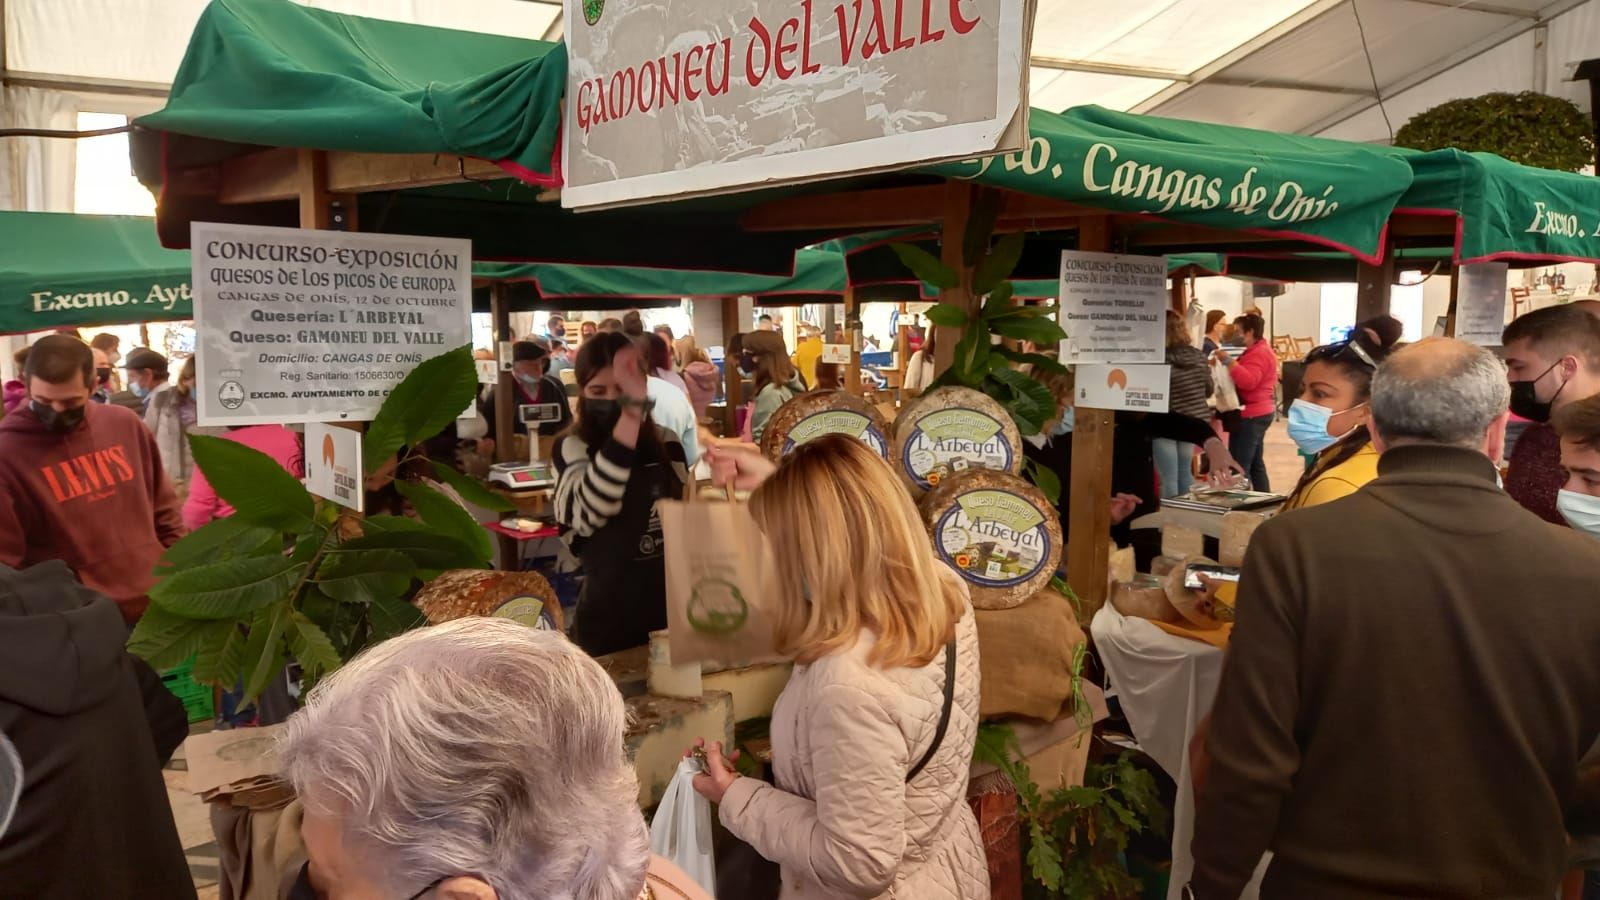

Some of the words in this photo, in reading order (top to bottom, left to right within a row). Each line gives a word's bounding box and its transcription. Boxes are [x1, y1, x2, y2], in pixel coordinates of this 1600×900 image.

[577, 37, 731, 136] GAMONEU
[745, 0, 821, 87] DEL
[1083, 143, 1223, 214] Cangas
[1226, 167, 1267, 215] de
[207, 241, 458, 270] CONCURSO-EXPOSICIÓN
[210, 267, 273, 286] QUESOS
[278, 267, 298, 286] DE
[302, 268, 330, 287] LOS
[334, 272, 376, 290] PICOS
[380, 272, 398, 289] DE
[402, 276, 457, 294] EUROPA
[31, 290, 139, 312] Excmo.
[217, 291, 280, 302] CANGAS
[284, 292, 304, 302] DE
[310, 293, 350, 304] ONÍS,
[356, 296, 367, 305] 12
[372, 295, 391, 305] DE
[395, 297, 457, 307] OCTUBRE
[251, 309, 334, 322] Quesería:
[229, 330, 292, 344] Queso:
[297, 330, 367, 344] GAMONEU
[372, 331, 399, 344] DEL
[404, 332, 445, 345] VALLE
[258, 353, 319, 363] Domicilio:
[322, 353, 373, 363] CANGAS
[377, 353, 392, 363] DE
[395, 352, 422, 363] ONÍS
[306, 371, 350, 381] Sanitario:
[250, 391, 288, 399] EXCMO.
[291, 390, 365, 399] AYUNTAMIENTO
[41, 444, 135, 503] LEVI'S
